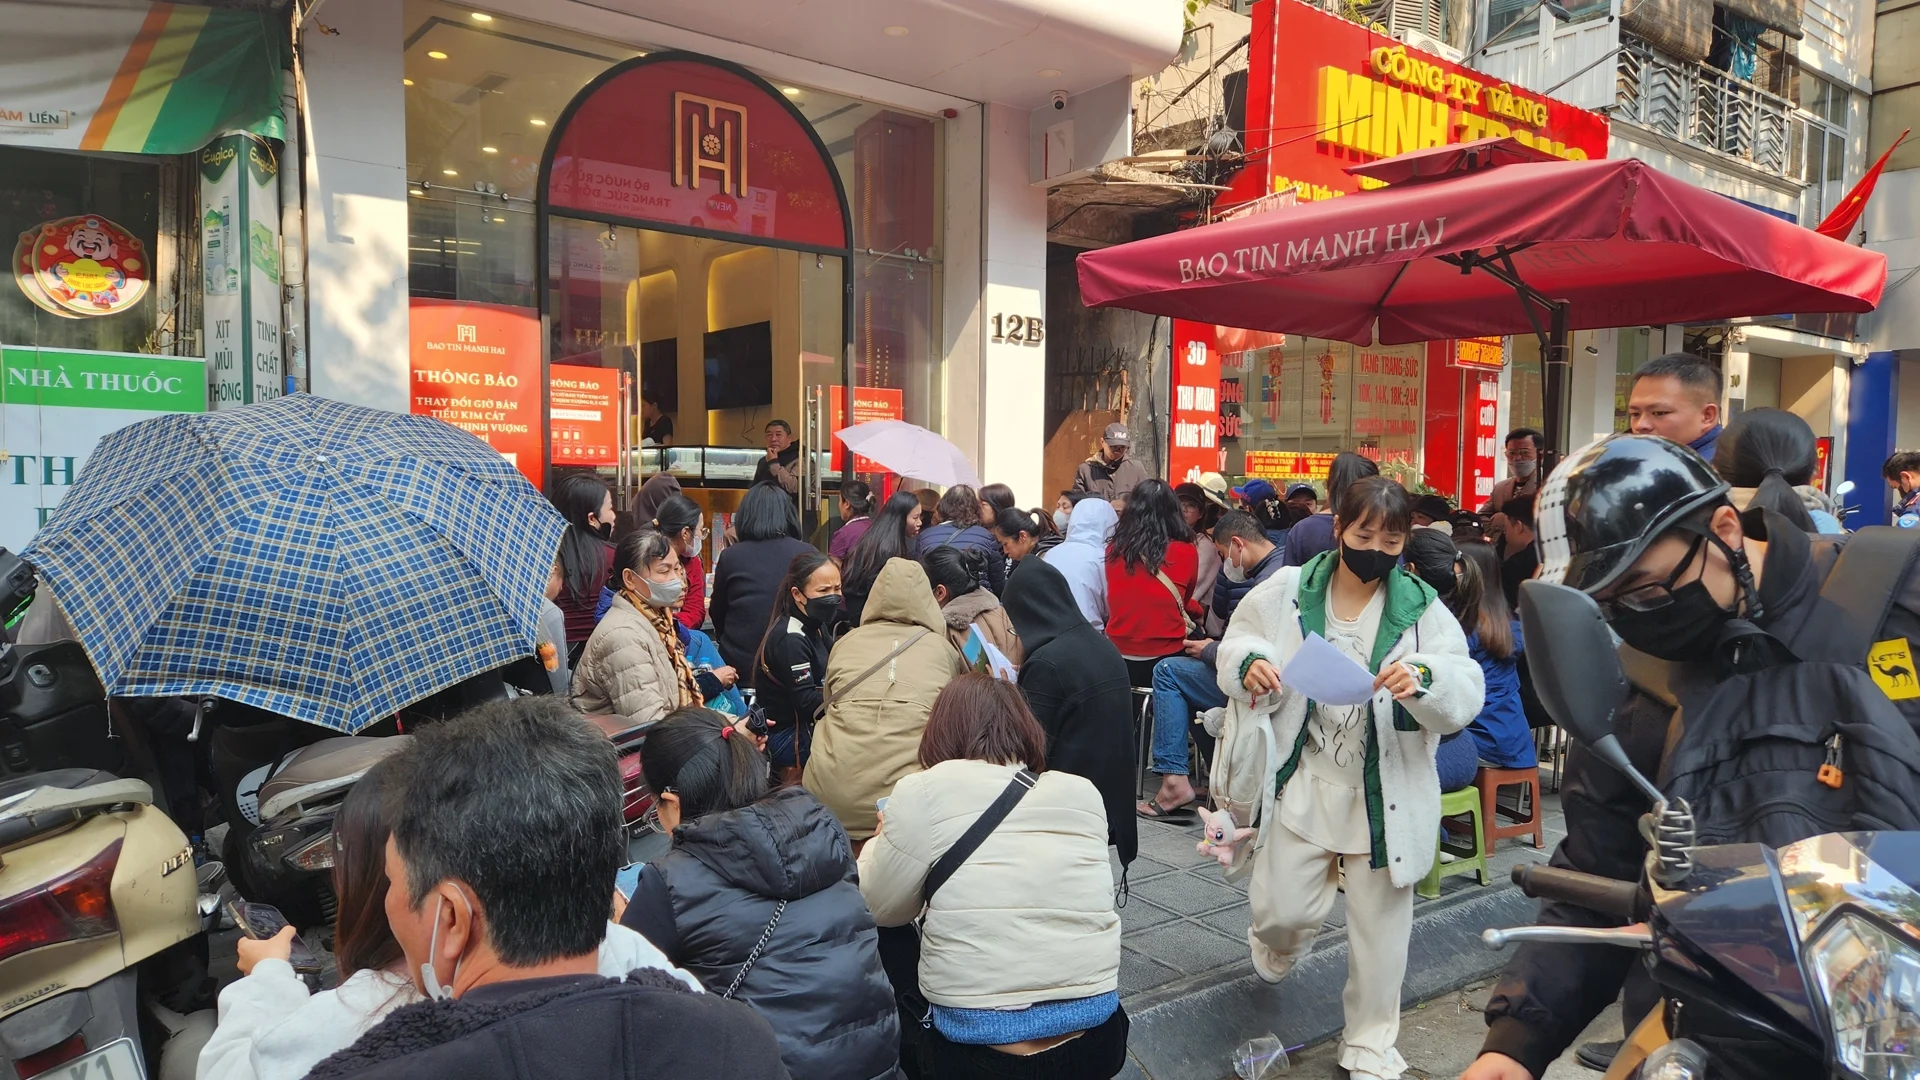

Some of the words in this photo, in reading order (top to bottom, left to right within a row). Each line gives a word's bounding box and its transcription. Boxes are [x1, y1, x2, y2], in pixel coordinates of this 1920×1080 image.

[1370, 45, 1444, 93] CÔNG
[1445, 73, 1482, 105] TY
[1483, 83, 1548, 127] VÀNG
[1318, 65, 1449, 158] MINH
[202, 148, 234, 166] Eugica
[249, 147, 276, 174] Eugica
[1178, 252, 1229, 283] BAO
[1233, 243, 1280, 274] TIN
[1285, 227, 1378, 267] MANH
[215, 319, 230, 344] XỊT
[256, 319, 277, 344] TINH
[992, 313, 1044, 346] 12B
[214, 347, 233, 371] MŨI
[427, 342, 445, 350] BAO
[446, 343, 462, 351] TIN
[463, 344, 489, 354] MANH
[490, 346, 506, 355] HAI
[1187, 340, 1207, 366] 3D
[256, 350, 279, 375] CHẤT
[1360, 350, 1379, 374] VÀNG
[1381, 355, 1403, 376] TRANG
[1404, 356, 1419, 378] SỨC
[8, 365, 74, 389] NHÀ
[80, 370, 182, 395] THUỐC
[208, 379, 242, 402] THÔNG
[413, 368, 480, 386] THÔNG
[484, 371, 518, 388] BÁO
[579, 380, 600, 391] BÁO
[415, 396, 448, 407] THAY
[450, 395, 472, 408] ĐỔI
[473, 398, 494, 408] GIỜ
[496, 400, 518, 410] BÁN
[1177, 385, 1194, 411] THU
[1195, 387, 1215, 412] MUA
[430, 407, 459, 419] TIỂU
[460, 410, 483, 420] KIM
[485, 411, 506, 421] CÁT
[1218, 412, 1243, 437] SỨC
[490, 423, 528, 434] VƯỢNG
[1175, 419, 1199, 448] VÀNG
[1199, 420, 1216, 448] TÂY
[1871, 651, 1906, 663] LET'S
